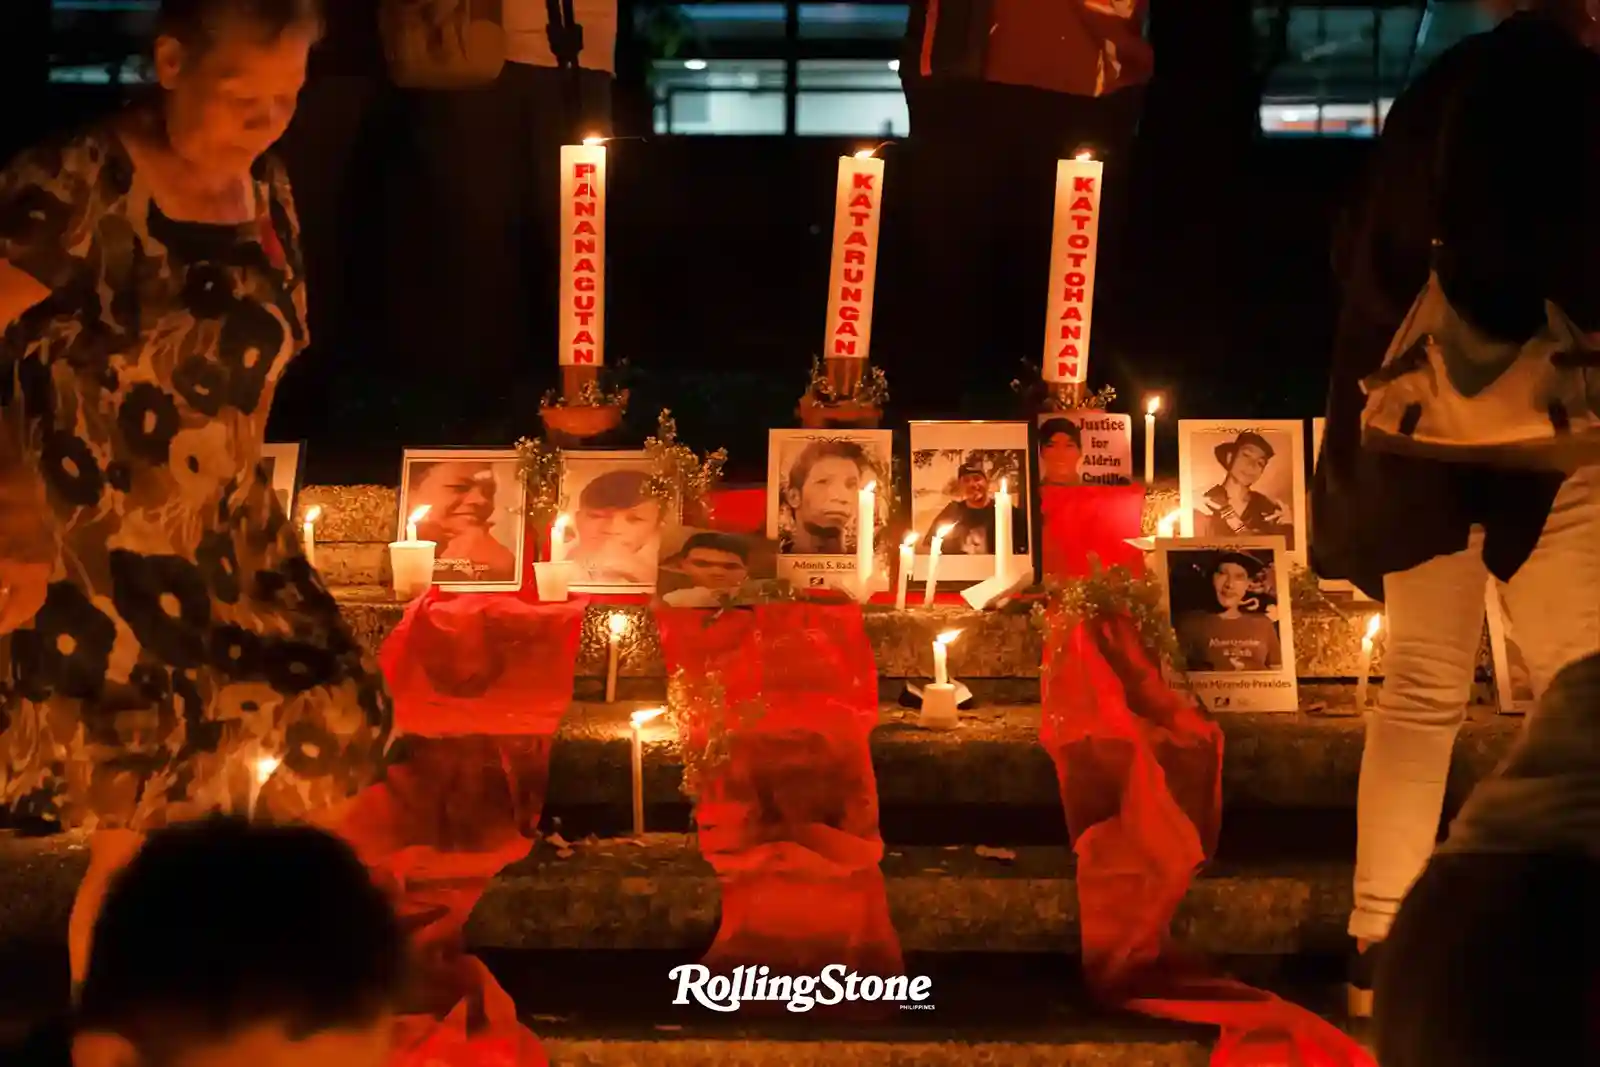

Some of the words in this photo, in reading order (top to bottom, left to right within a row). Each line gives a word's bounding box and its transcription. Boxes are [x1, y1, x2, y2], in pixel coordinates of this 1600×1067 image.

[573, 163, 597, 364] PANANAGUTAN
[835, 173, 875, 355] KATARUNGAN
[1058, 176, 1095, 377] KATOTOHANAN
[1079, 417, 1125, 431] Justice
[1091, 437, 1109, 449] for
[1082, 454, 1121, 467] Aldrin
[793, 561, 825, 570] Adonis
